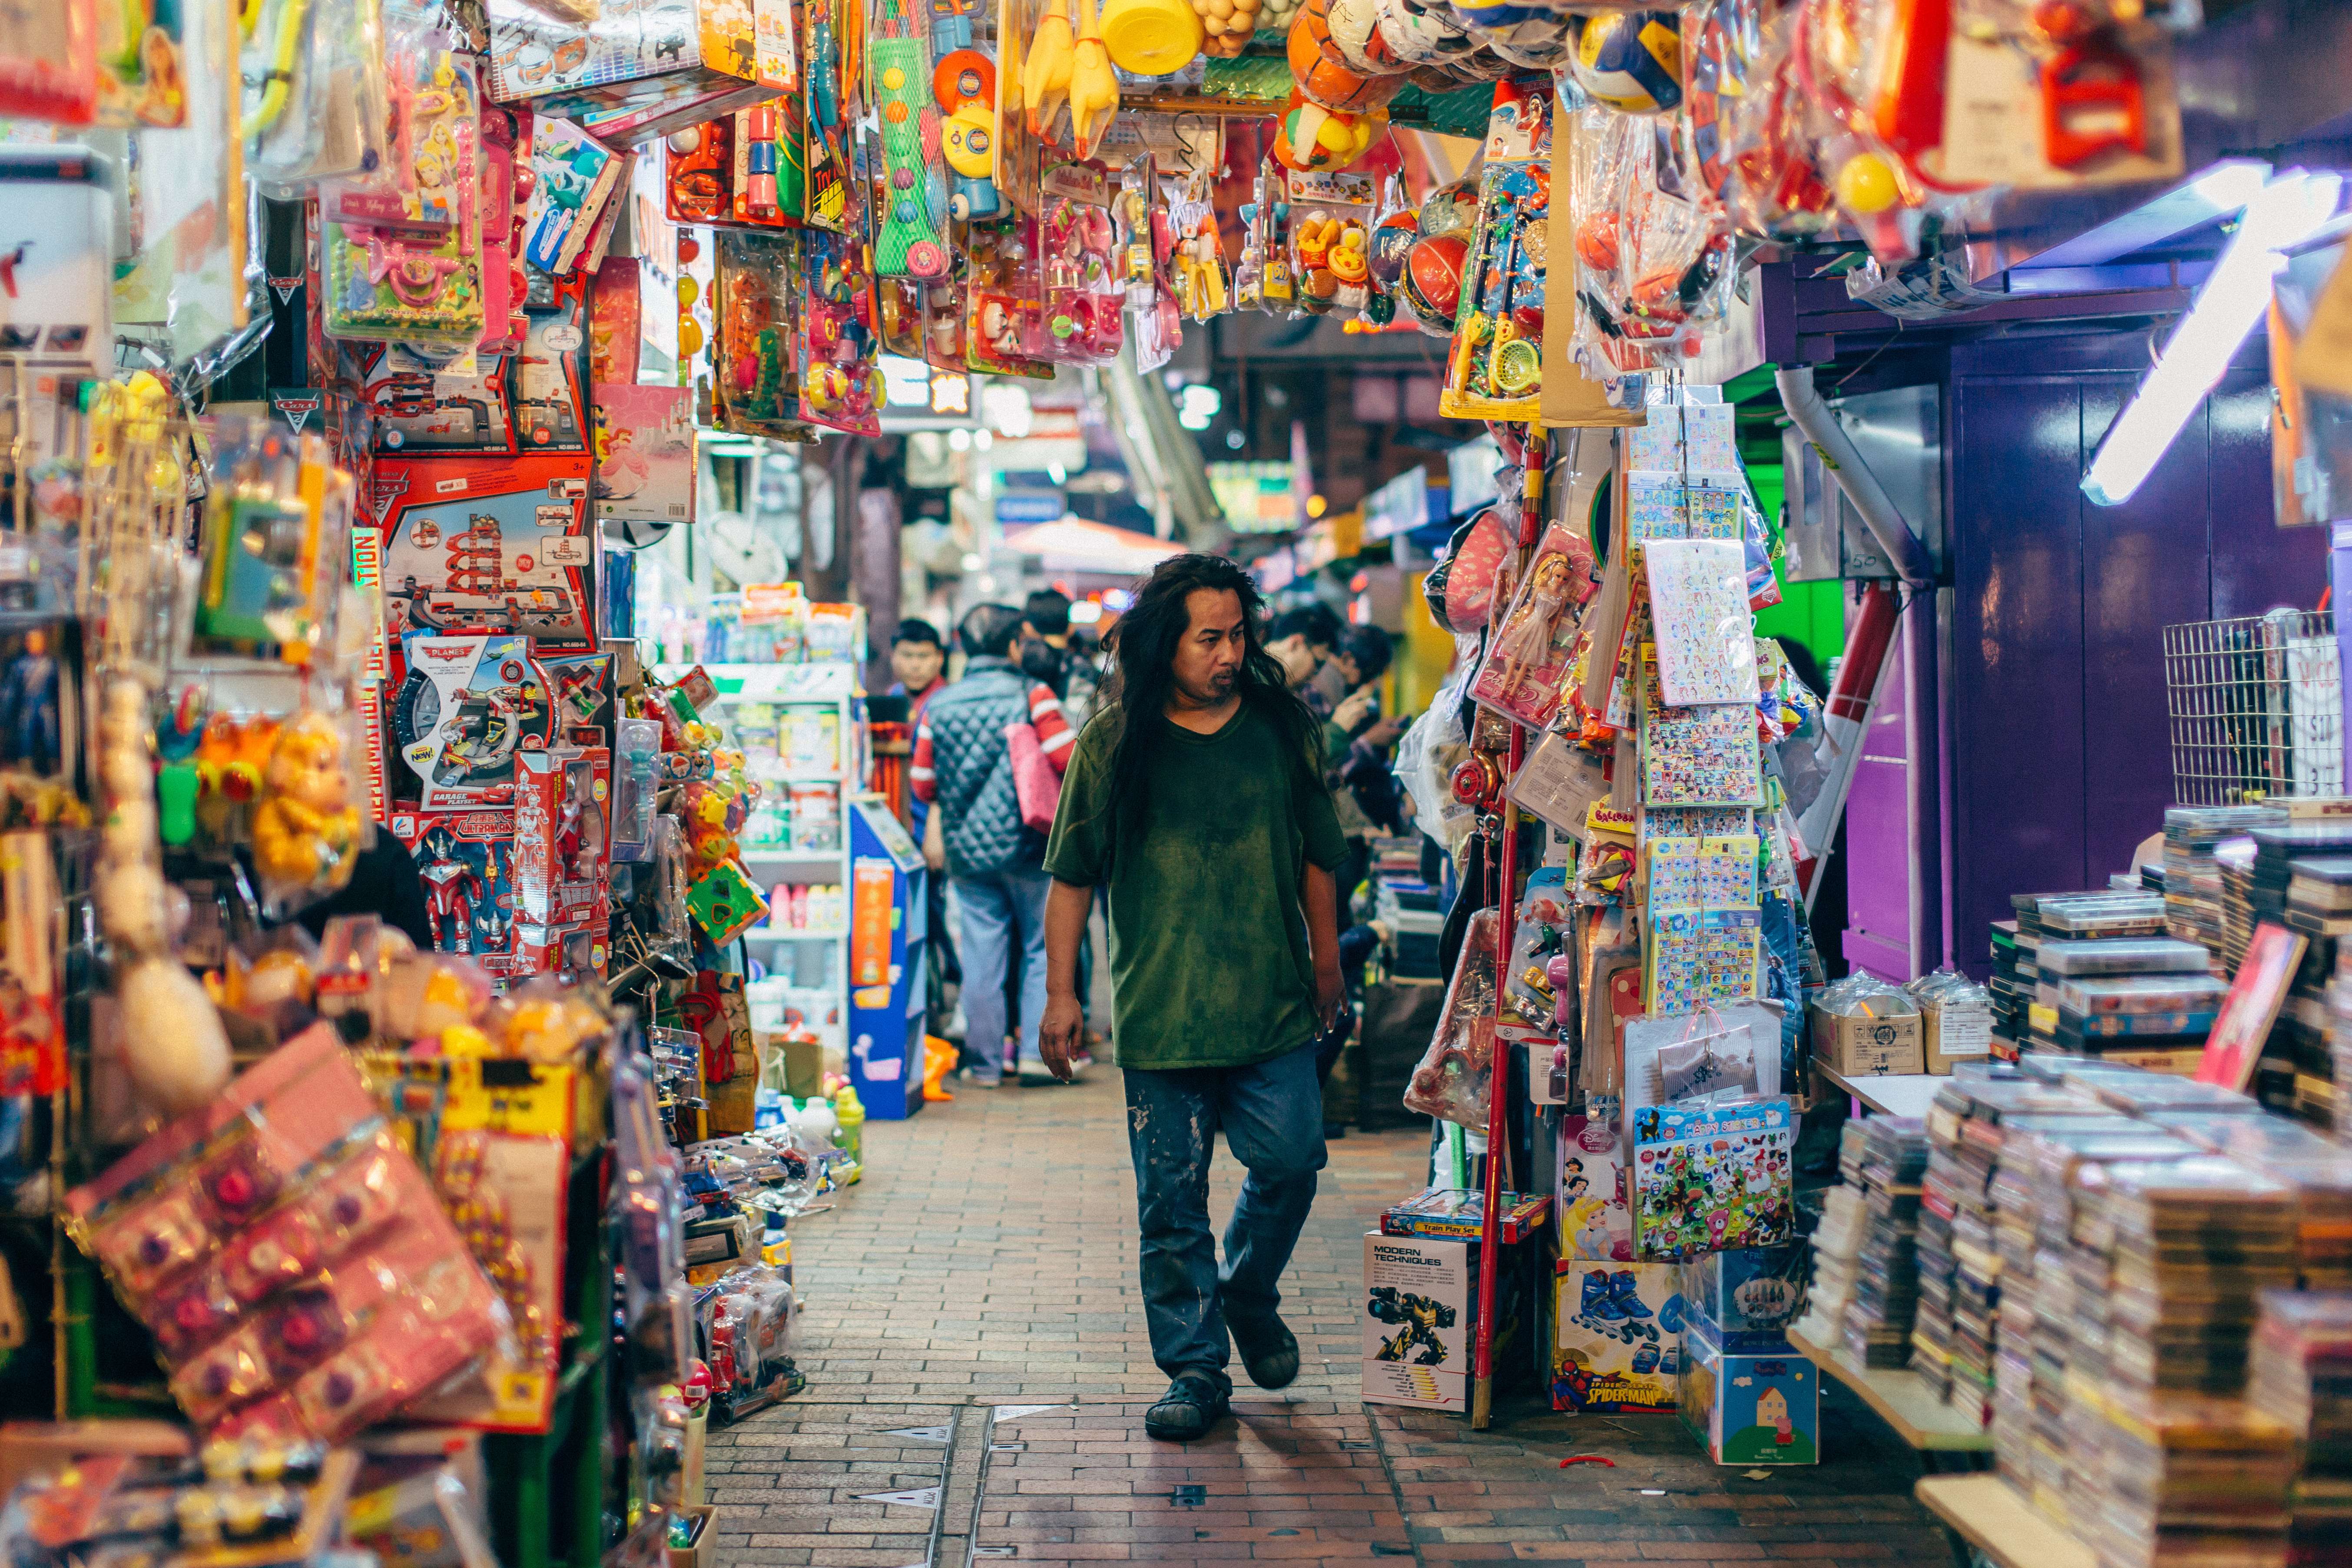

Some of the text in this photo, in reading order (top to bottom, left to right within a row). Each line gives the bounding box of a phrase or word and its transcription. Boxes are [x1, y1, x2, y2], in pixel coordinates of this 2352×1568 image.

[280, 401, 313, 409] Cars
[292, 415, 302, 423] 2
[573, 463, 585, 471] 3+
[1774, 544, 1783, 560] NEW
[432, 648, 465, 656] PLANES
[1685, 1122, 1719, 1137] HAPPY
[1423, 1224, 1443, 1232] Train
[1445, 1226, 1461, 1234] Play
[1374, 1245, 1421, 1256] MODERN
[1374, 1253, 1441, 1266] TECHNIQUES
[1586, 1388, 1656, 1406] SPIDER-MAN
[923, 1491, 936, 1505] PCCW
